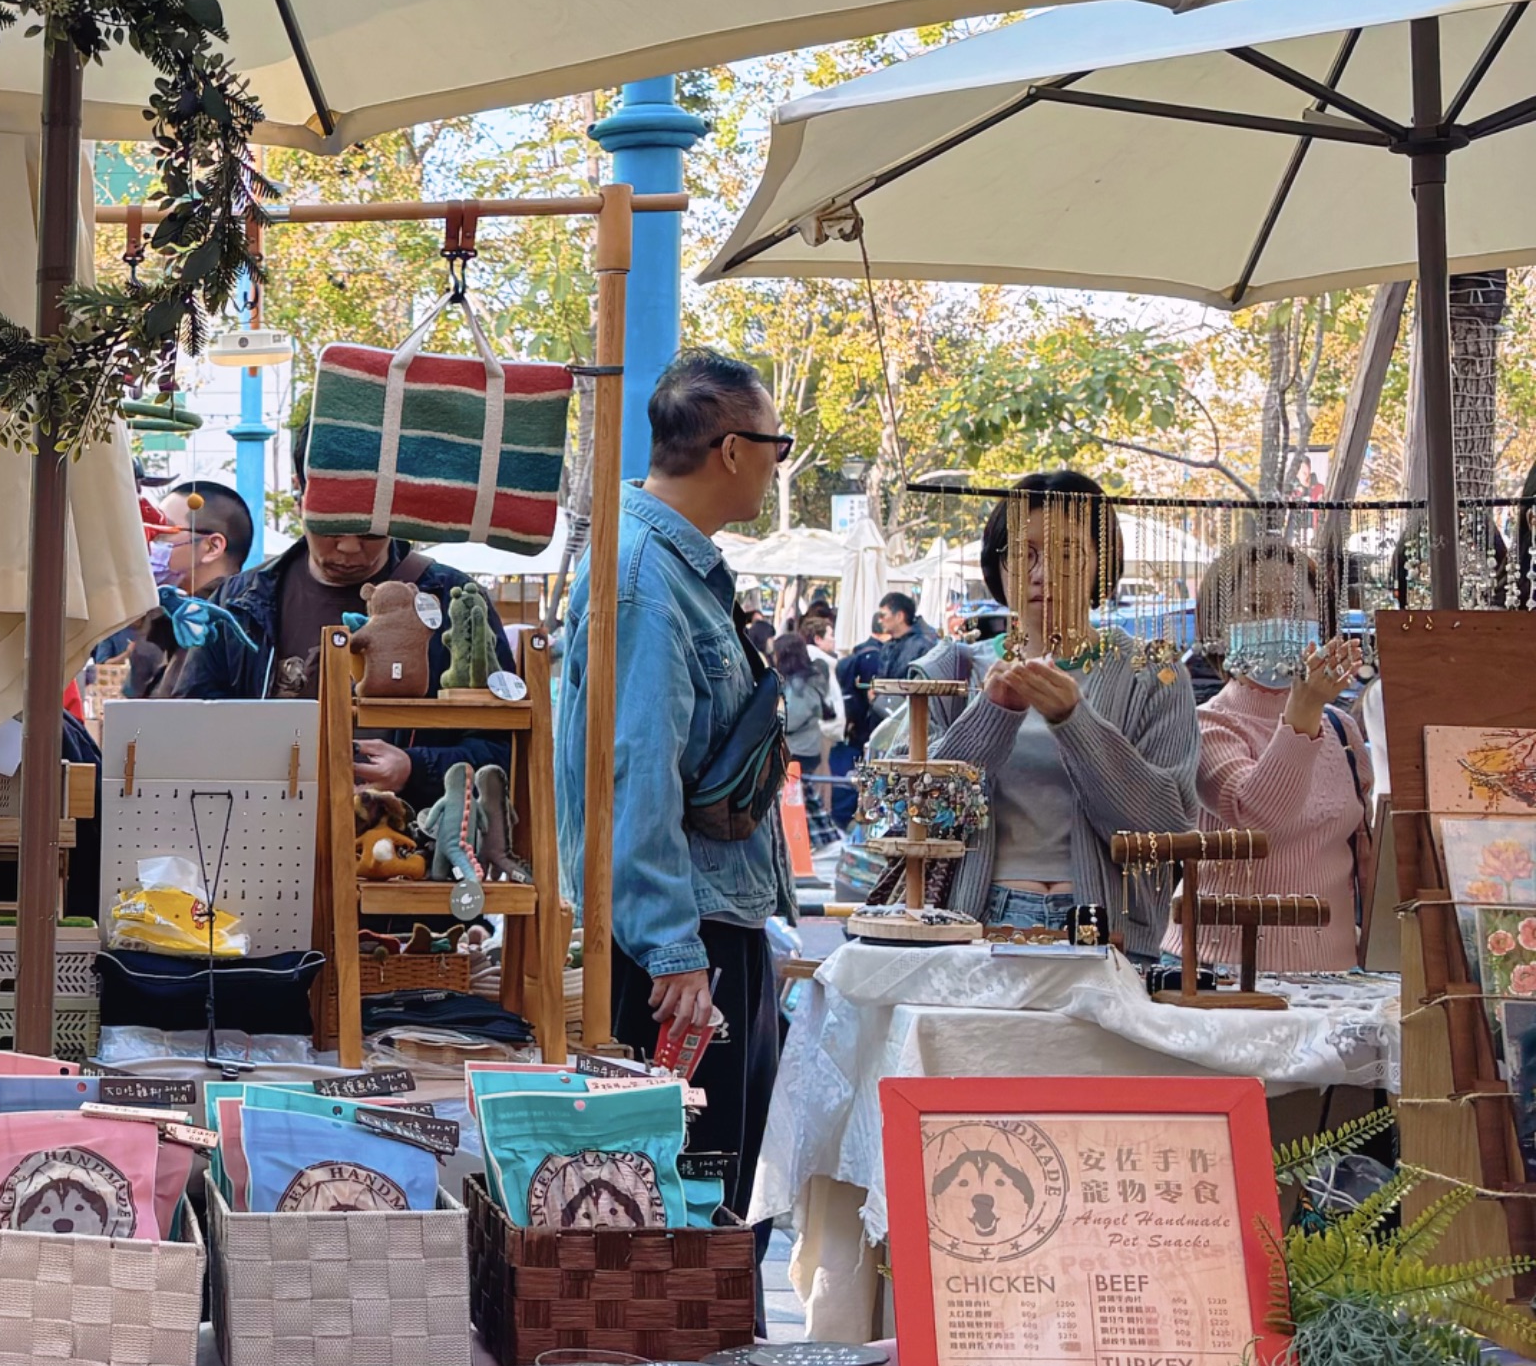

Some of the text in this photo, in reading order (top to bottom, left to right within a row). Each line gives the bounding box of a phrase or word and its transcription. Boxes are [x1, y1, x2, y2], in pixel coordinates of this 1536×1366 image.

[1077, 1147, 1217, 1174] 安佐手作
[1080, 1178, 1221, 1205] 寵物零食
[1071, 1208, 1232, 1230] Angel Handmade
[1107, 1232, 1211, 1249] Pet Snacks
[945, 1275, 1056, 1294] CHICKEN
[1095, 1274, 1150, 1293] BEEF
